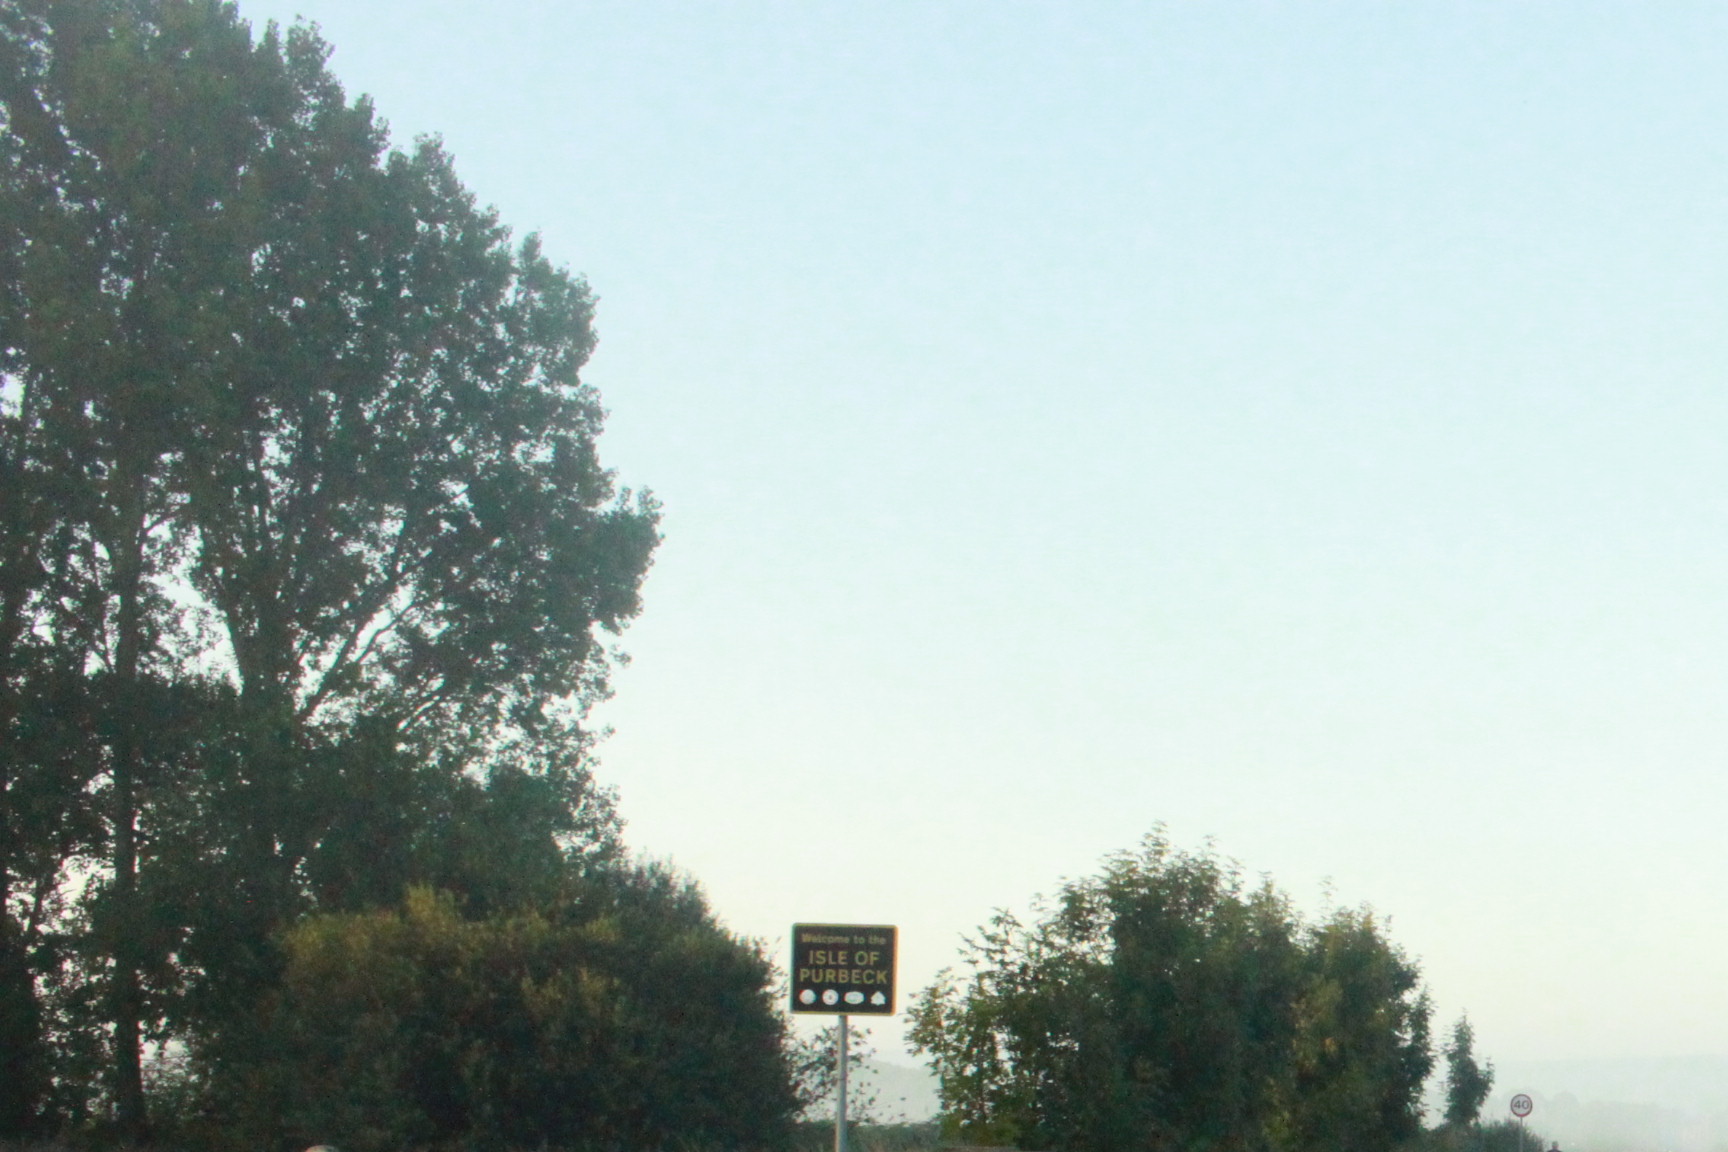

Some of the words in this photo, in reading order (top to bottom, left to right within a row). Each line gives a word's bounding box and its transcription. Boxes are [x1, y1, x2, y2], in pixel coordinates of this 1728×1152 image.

[802, 933, 849, 944] Welcome
[854, 935, 865, 945] to
[869, 935, 886, 945] the
[809, 950, 848, 965] ISLE
[855, 951, 880, 966] OF
[800, 968, 888, 984] PURBECK
[1514, 1100, 1529, 1110] 40
